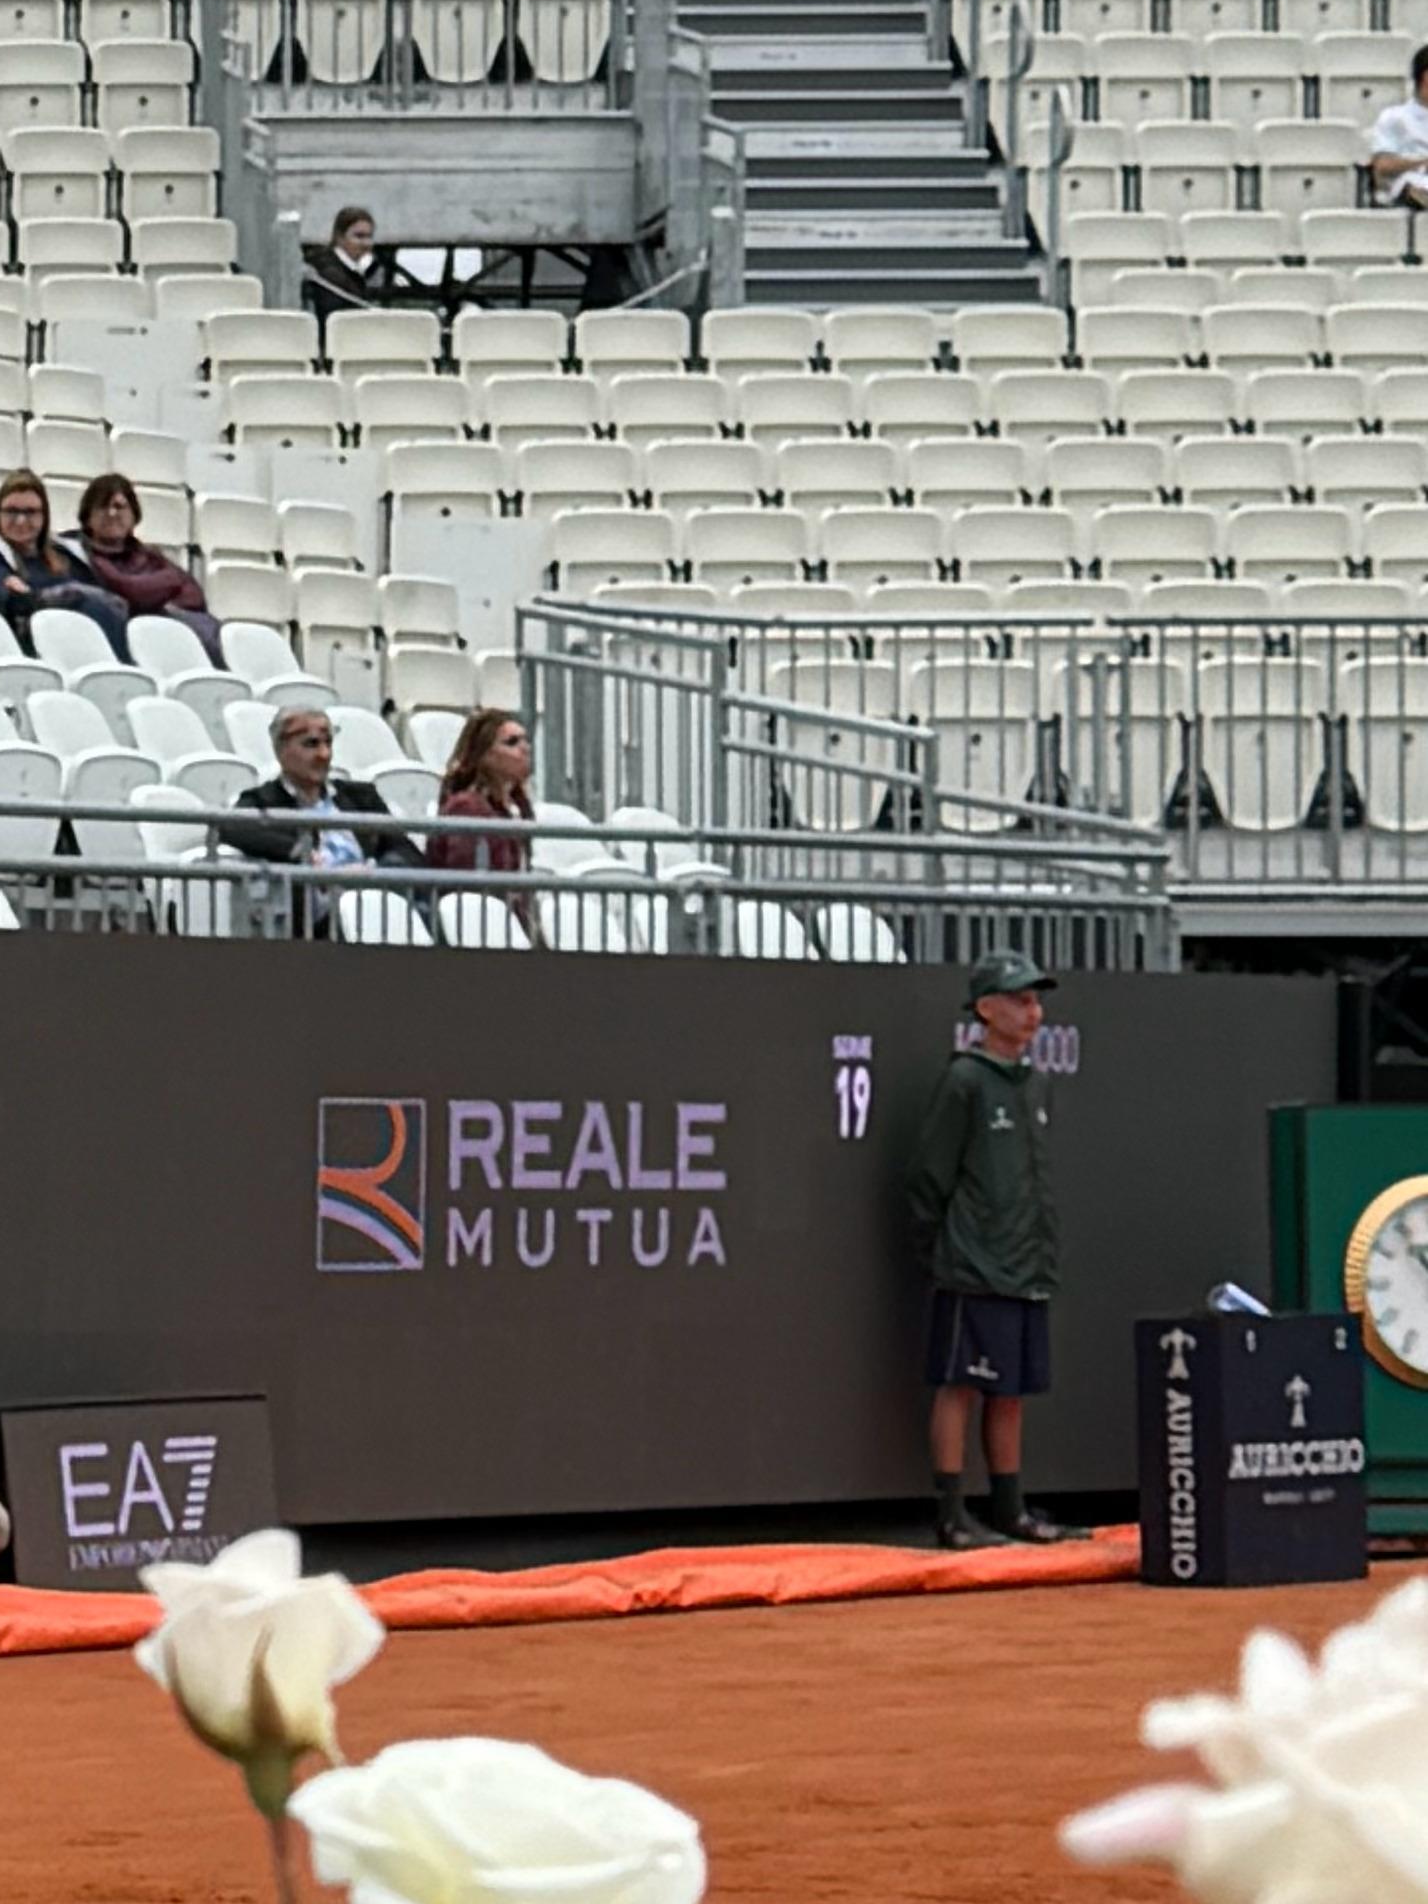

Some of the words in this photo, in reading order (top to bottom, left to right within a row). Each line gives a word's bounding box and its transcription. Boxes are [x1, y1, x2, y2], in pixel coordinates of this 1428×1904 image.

[448, 1099, 727, 1190] REALE
[835, 1066, 871, 1138] 19
[447, 1206, 727, 1267] MUTUA
[59, 1435, 217, 1538] EA7
[1166, 1388, 1198, 1580] AURICCHIO
